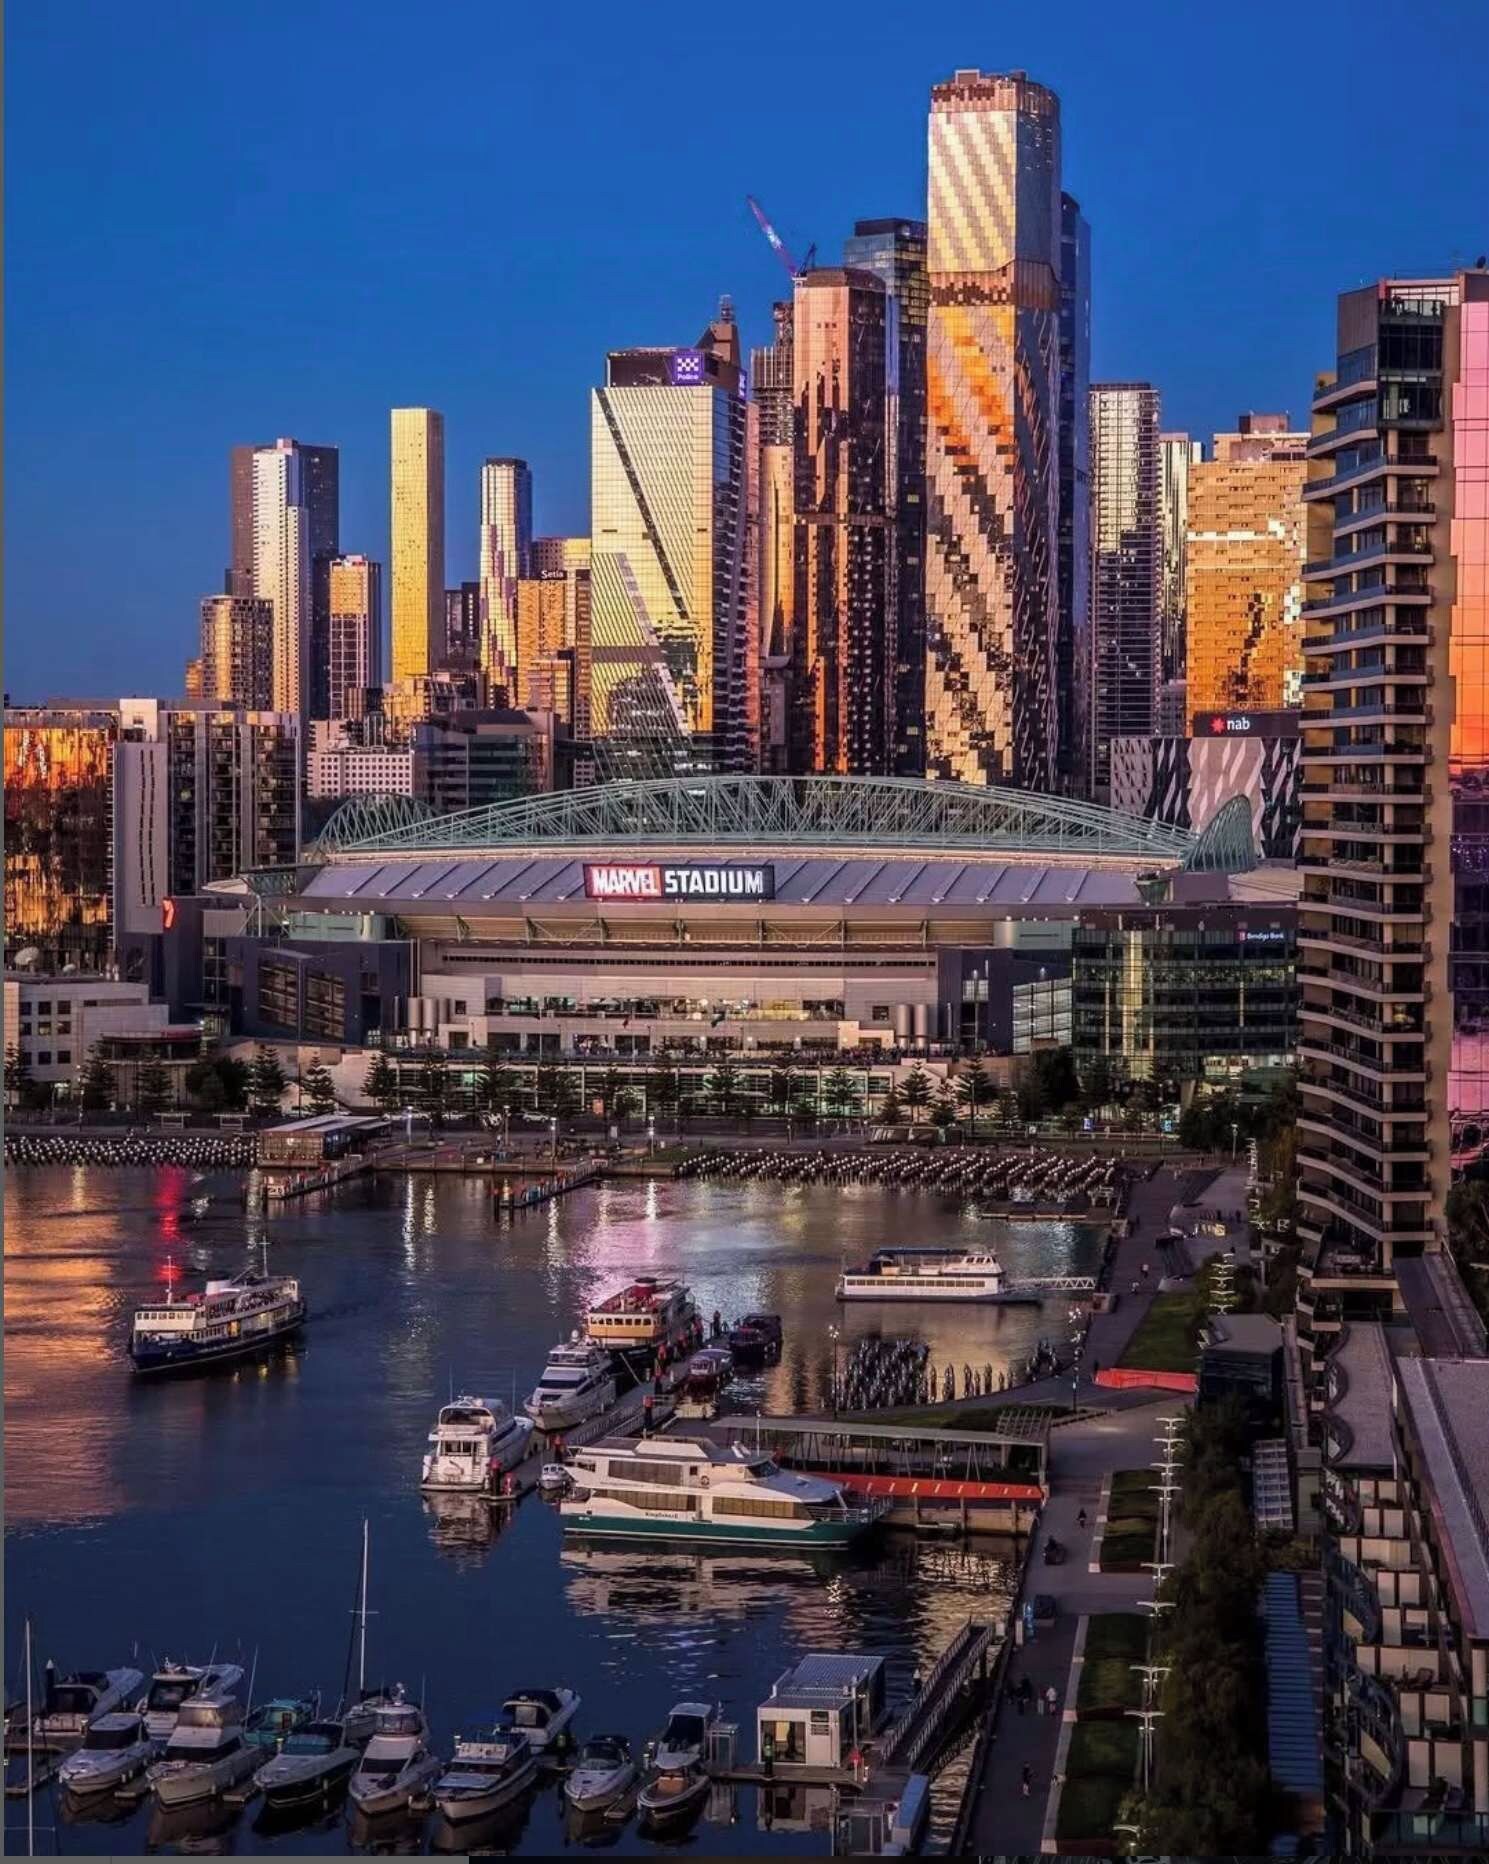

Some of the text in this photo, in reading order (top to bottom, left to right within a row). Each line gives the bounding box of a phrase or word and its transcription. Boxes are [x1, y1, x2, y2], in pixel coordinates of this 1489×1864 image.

[1226, 716, 1250, 730] nab
[593, 868, 764, 896] MARVEL STADIUM
